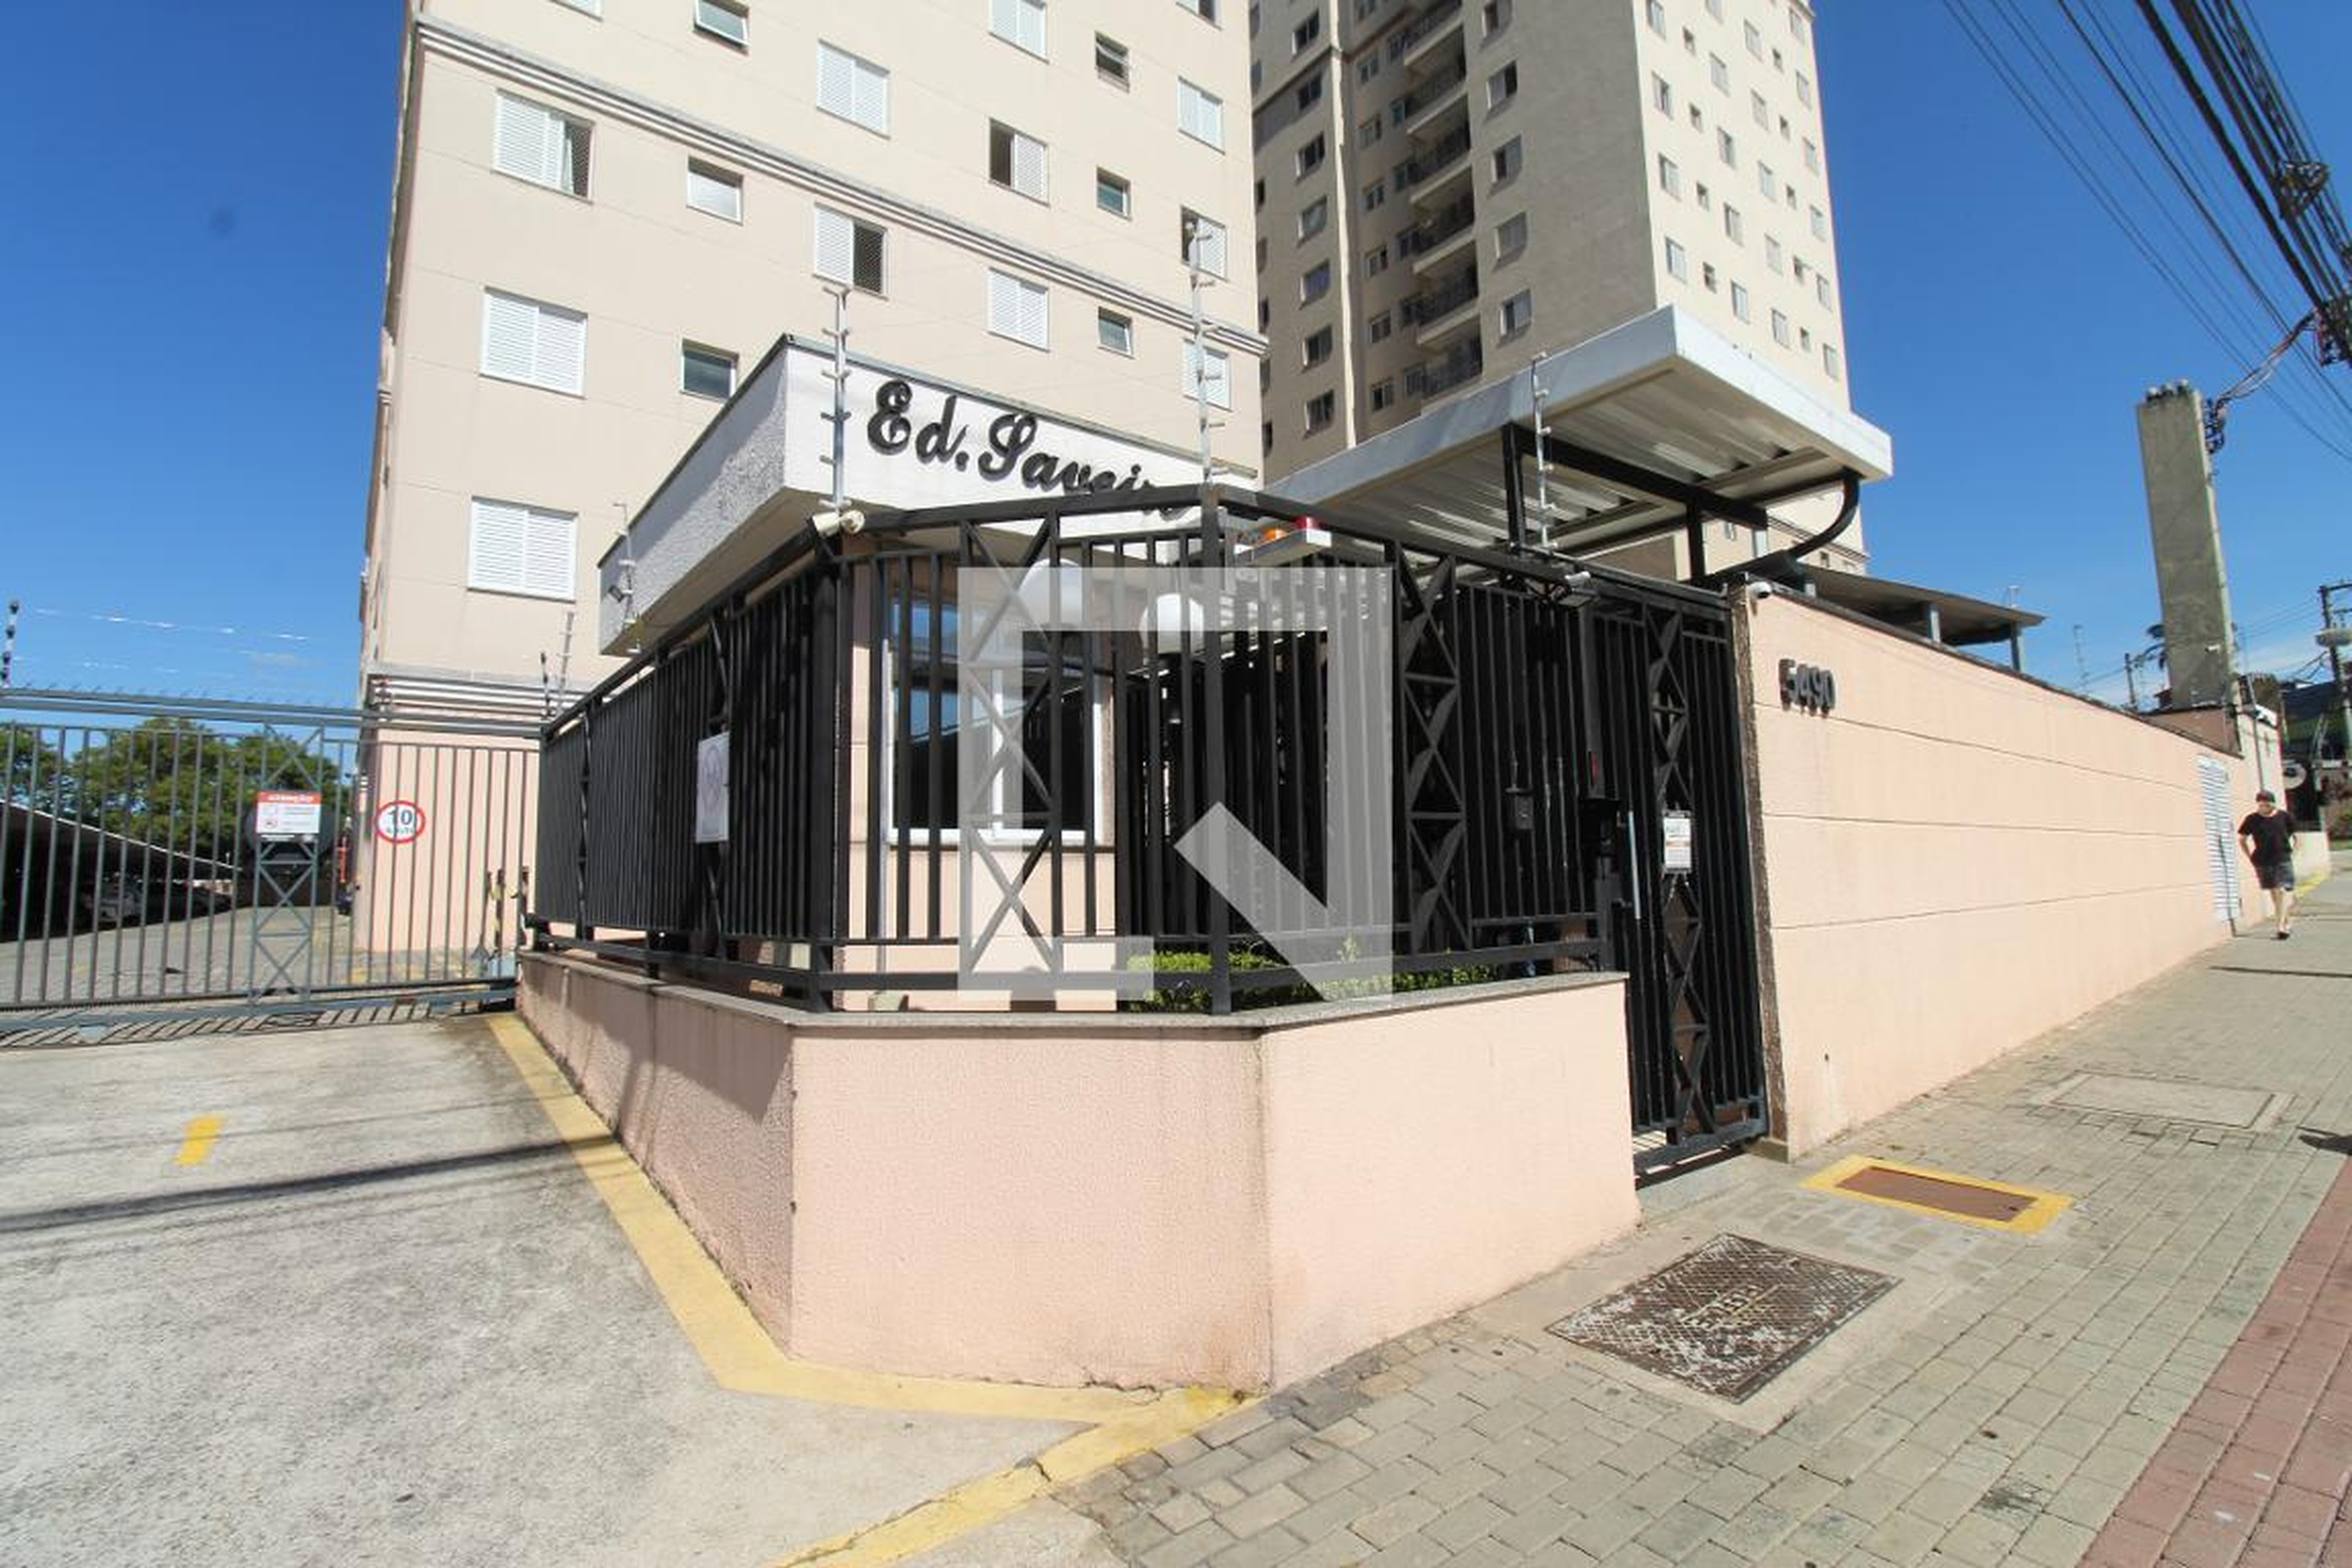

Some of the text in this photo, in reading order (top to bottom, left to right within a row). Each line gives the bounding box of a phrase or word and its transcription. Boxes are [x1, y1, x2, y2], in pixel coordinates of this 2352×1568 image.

[867, 380, 970, 472] Ed.
[1779, 658, 1836, 718] 5490
[388, 809, 413, 826] 10
